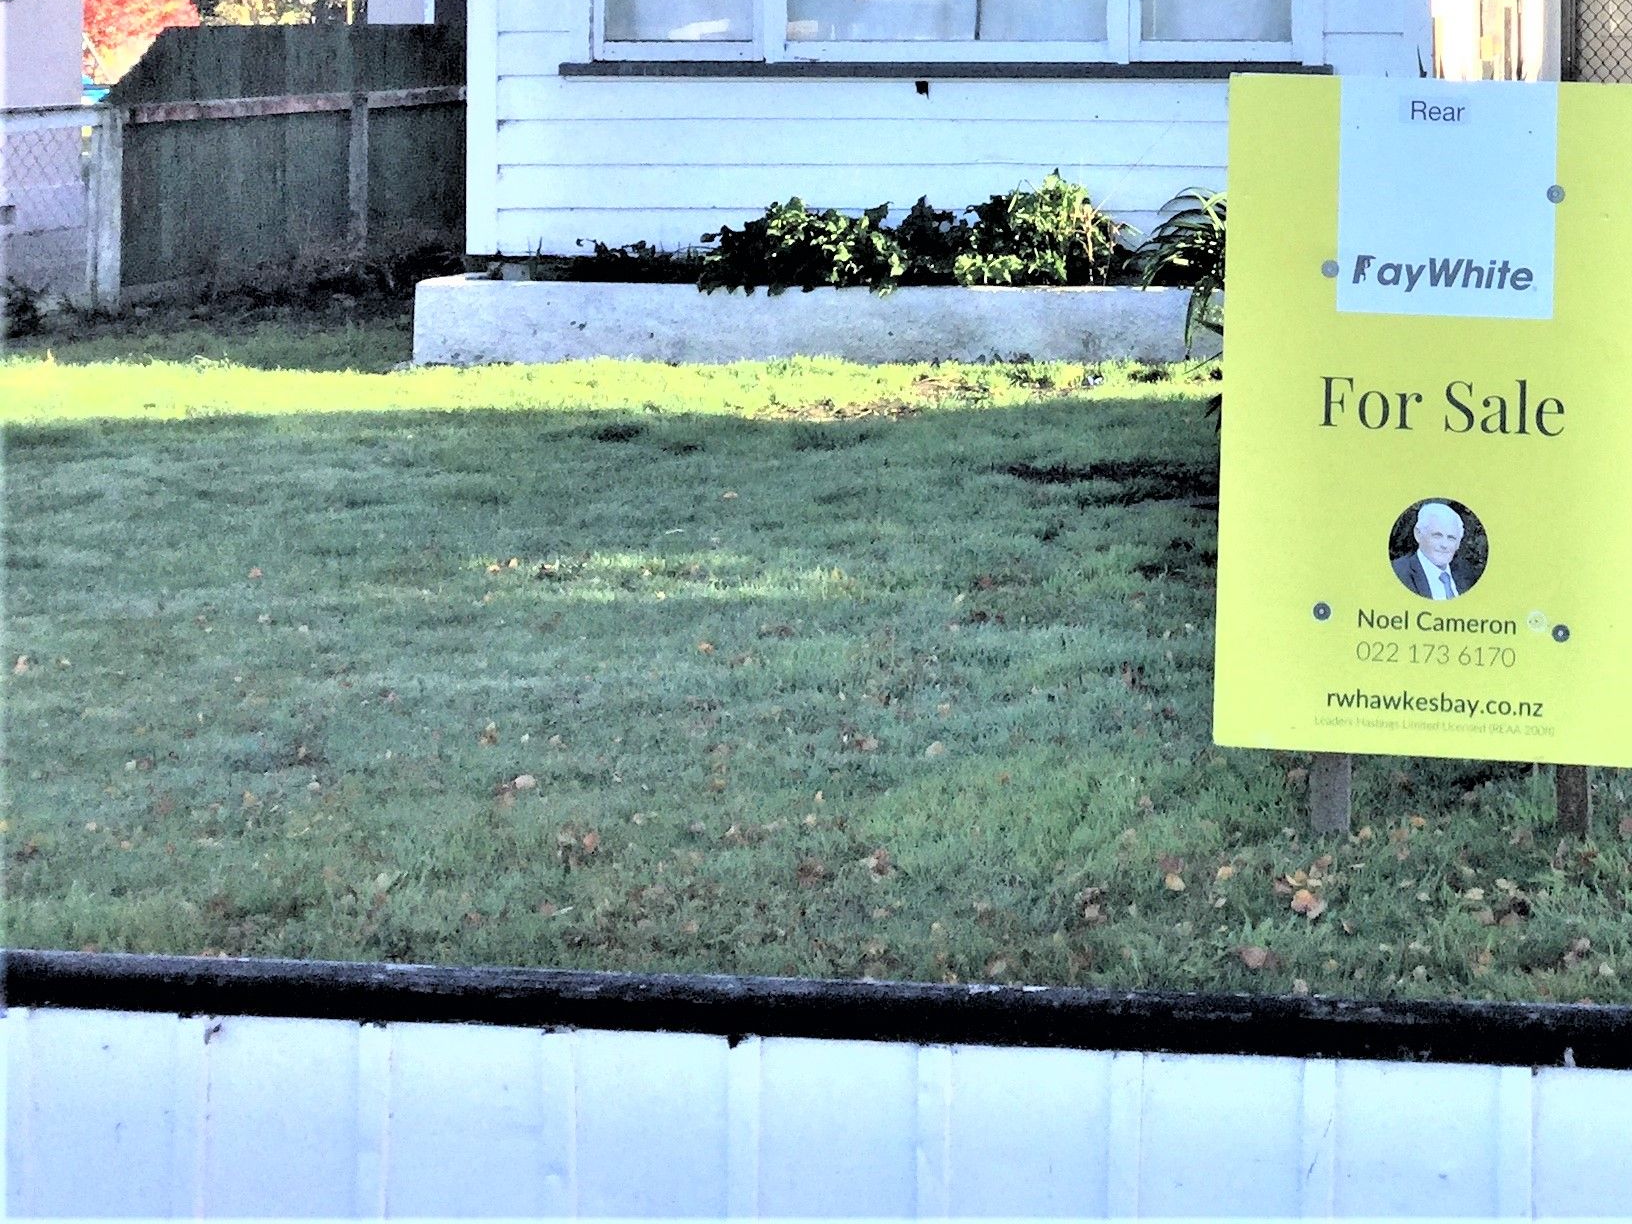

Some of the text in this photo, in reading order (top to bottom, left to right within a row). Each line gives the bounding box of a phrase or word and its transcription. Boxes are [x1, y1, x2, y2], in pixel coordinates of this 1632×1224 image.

[1411, 100, 1467, 122] Rear
[1319, 376, 1566, 437] For Sale
[1358, 609, 1518, 635] Noel Cameron
[1356, 640, 1517, 668] 022 173 6170
[1327, 689, 1543, 718] rwhawkesbay.co.nz
